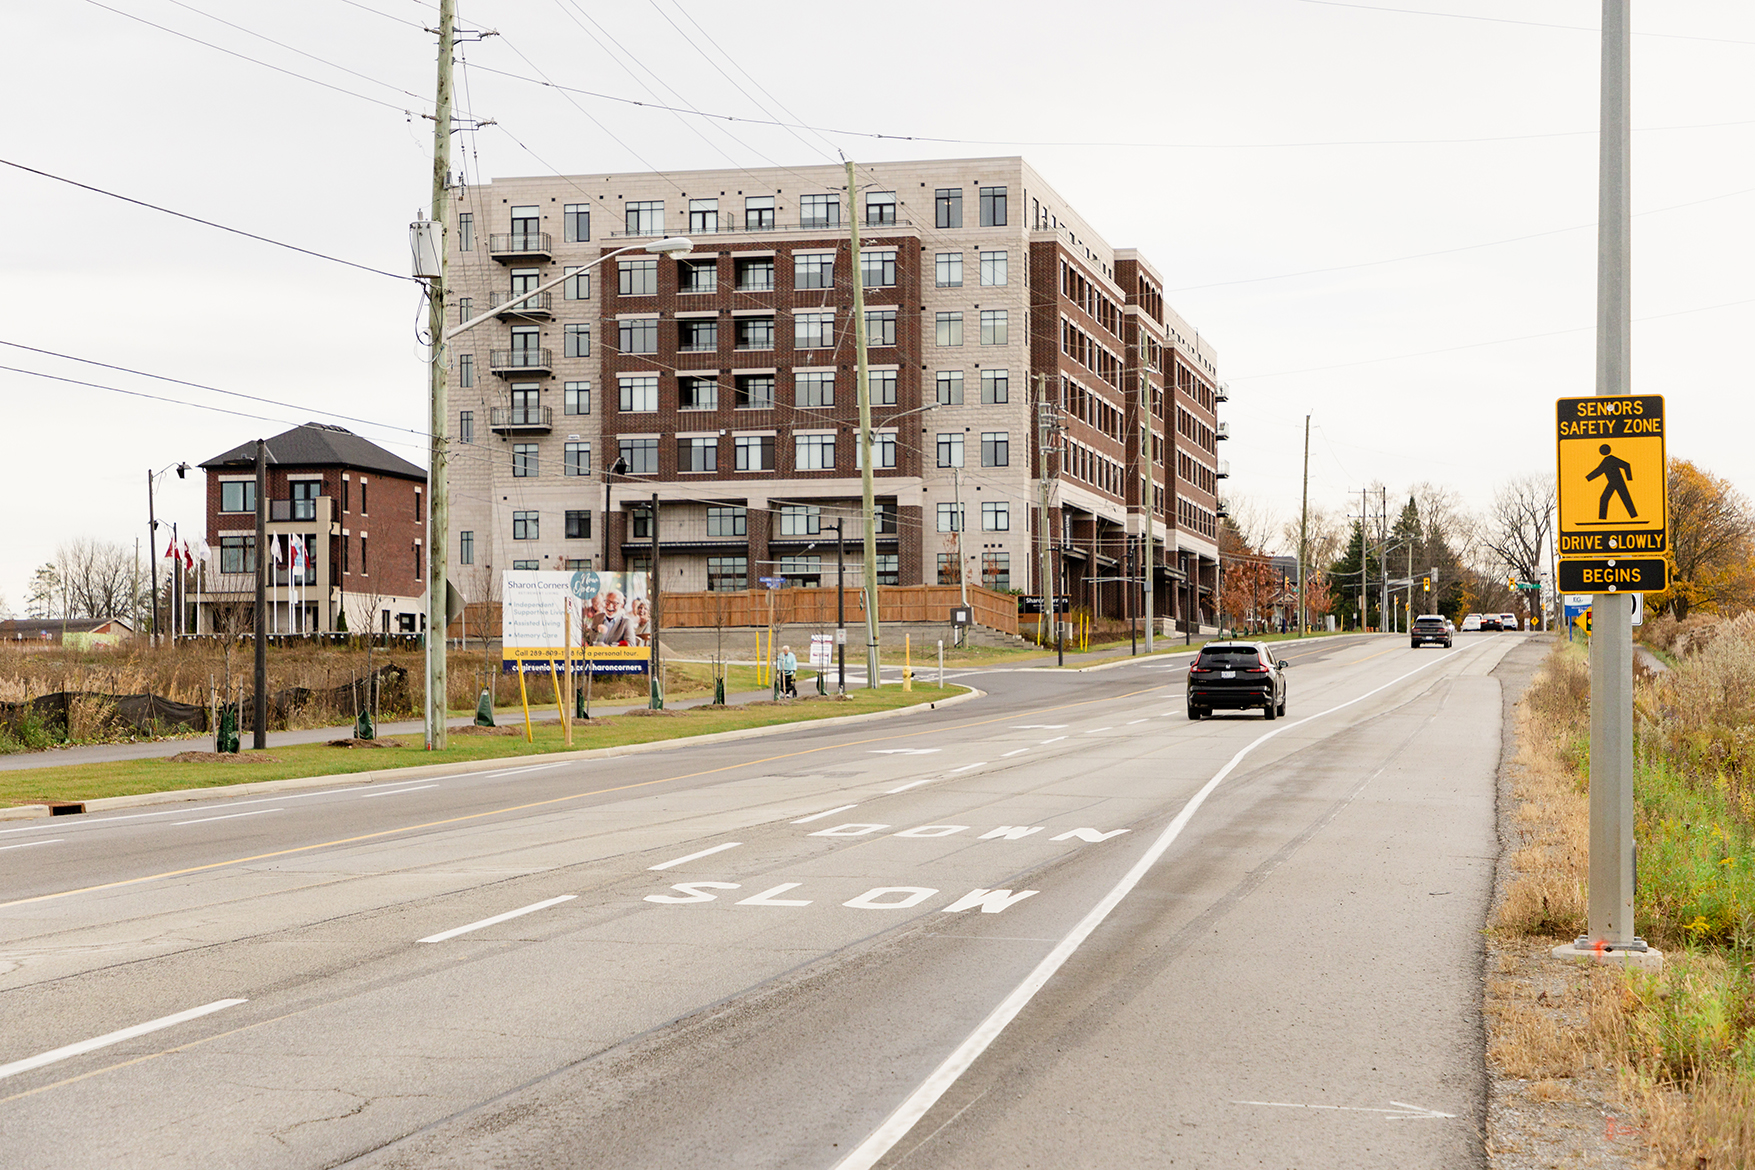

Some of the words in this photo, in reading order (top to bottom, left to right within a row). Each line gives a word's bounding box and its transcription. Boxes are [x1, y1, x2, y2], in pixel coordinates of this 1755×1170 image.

[1577, 400, 1643, 417] SENIORS
[1560, 419, 1616, 436] SAFETY
[1623, 418, 1661, 433] ZONE
[1561, 535, 1603, 550] DRIVE
[1608, 534, 1664, 549] SLOWLY
[1583, 568, 1641, 583] BEGINS
[508, 580, 536, 589] Sharon
[537, 580, 569, 589] Corners
[573, 580, 597, 596] Open
[541, 620, 561, 628] Living
[806, 823, 1132, 843] DOWN
[642, 881, 1041, 913] SLOW
